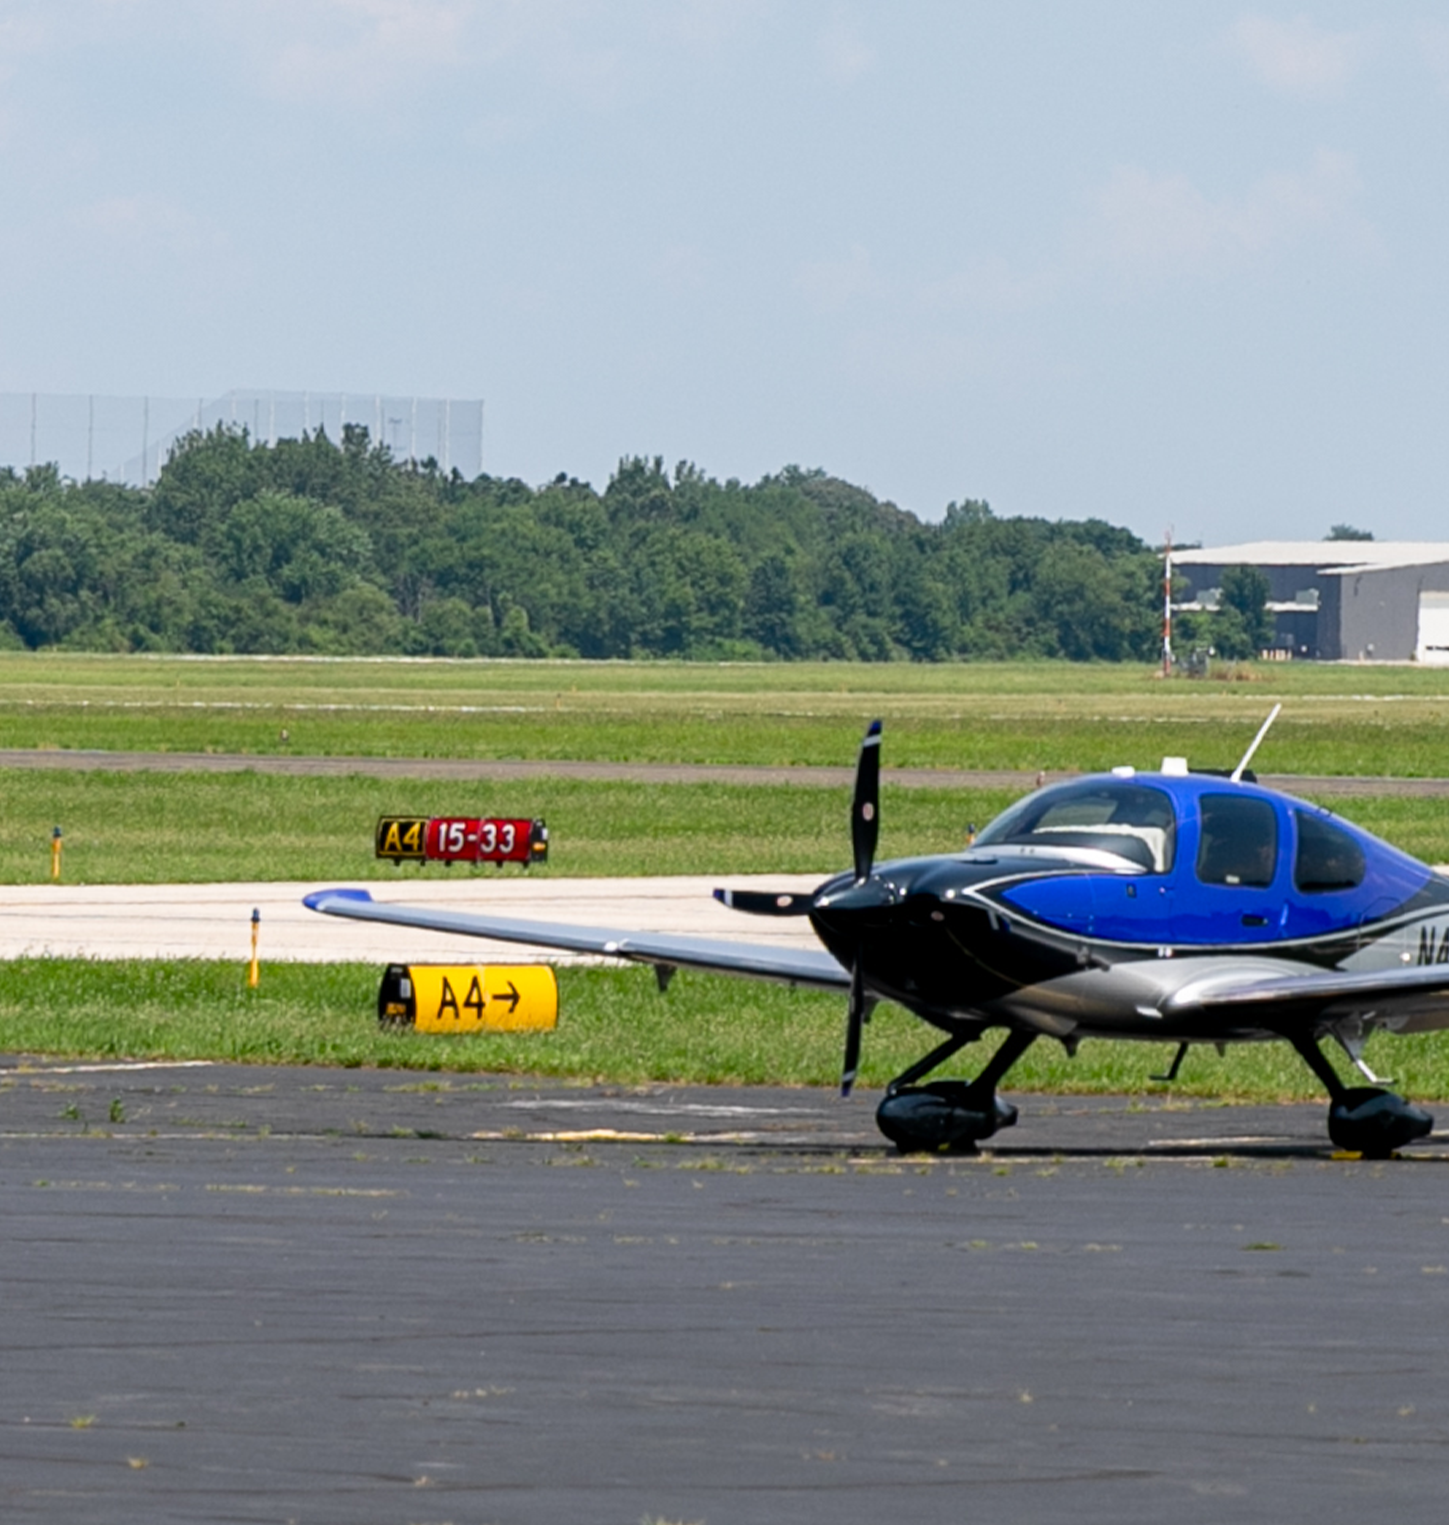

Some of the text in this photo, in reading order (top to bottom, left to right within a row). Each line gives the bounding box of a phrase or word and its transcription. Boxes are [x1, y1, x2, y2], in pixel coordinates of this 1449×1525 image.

[384, 821, 515, 853] A4 15-33
[436, 974, 486, 1020] A4
